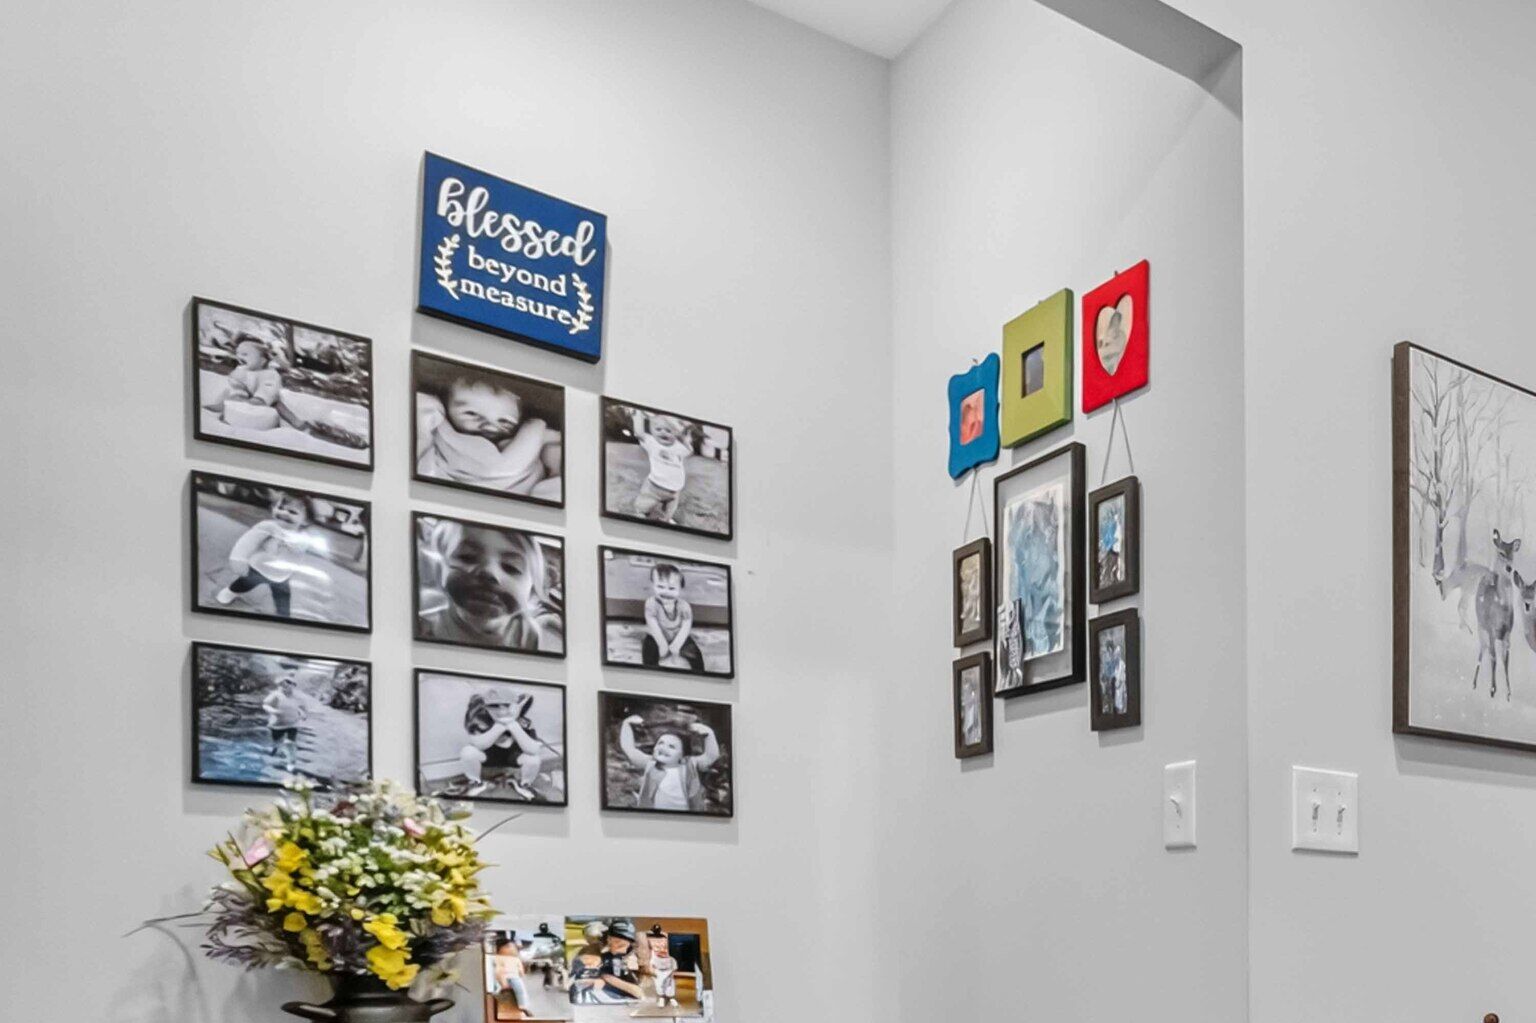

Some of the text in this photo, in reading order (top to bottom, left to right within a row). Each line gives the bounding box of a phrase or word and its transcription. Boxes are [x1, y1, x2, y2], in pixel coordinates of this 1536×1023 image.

[437, 177, 596, 266] blessed
[468, 245, 567, 296] beyond
[460, 278, 573, 325] measure
